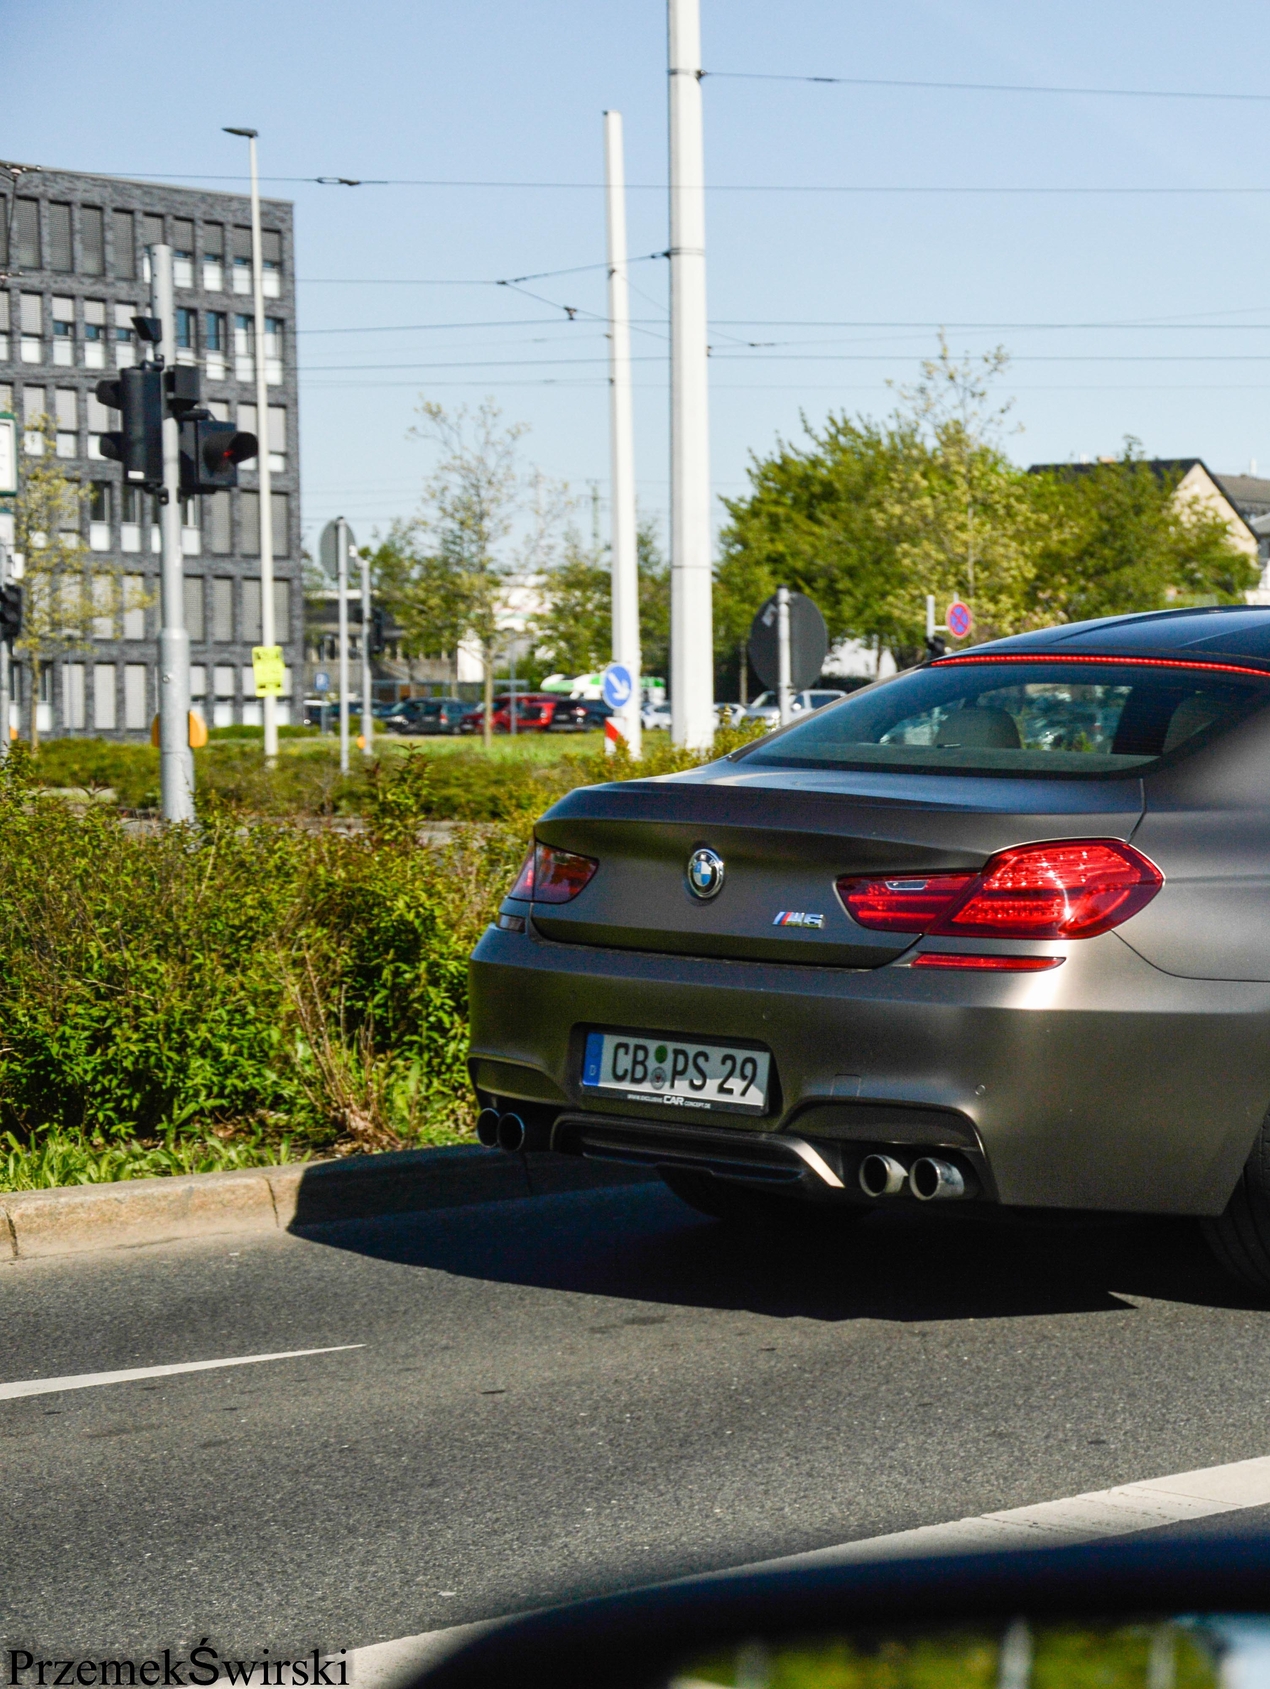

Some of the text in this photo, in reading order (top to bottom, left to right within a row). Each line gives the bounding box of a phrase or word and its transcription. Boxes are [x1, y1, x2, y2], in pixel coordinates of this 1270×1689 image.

[612, 1042, 758, 1097] CB PS 29
